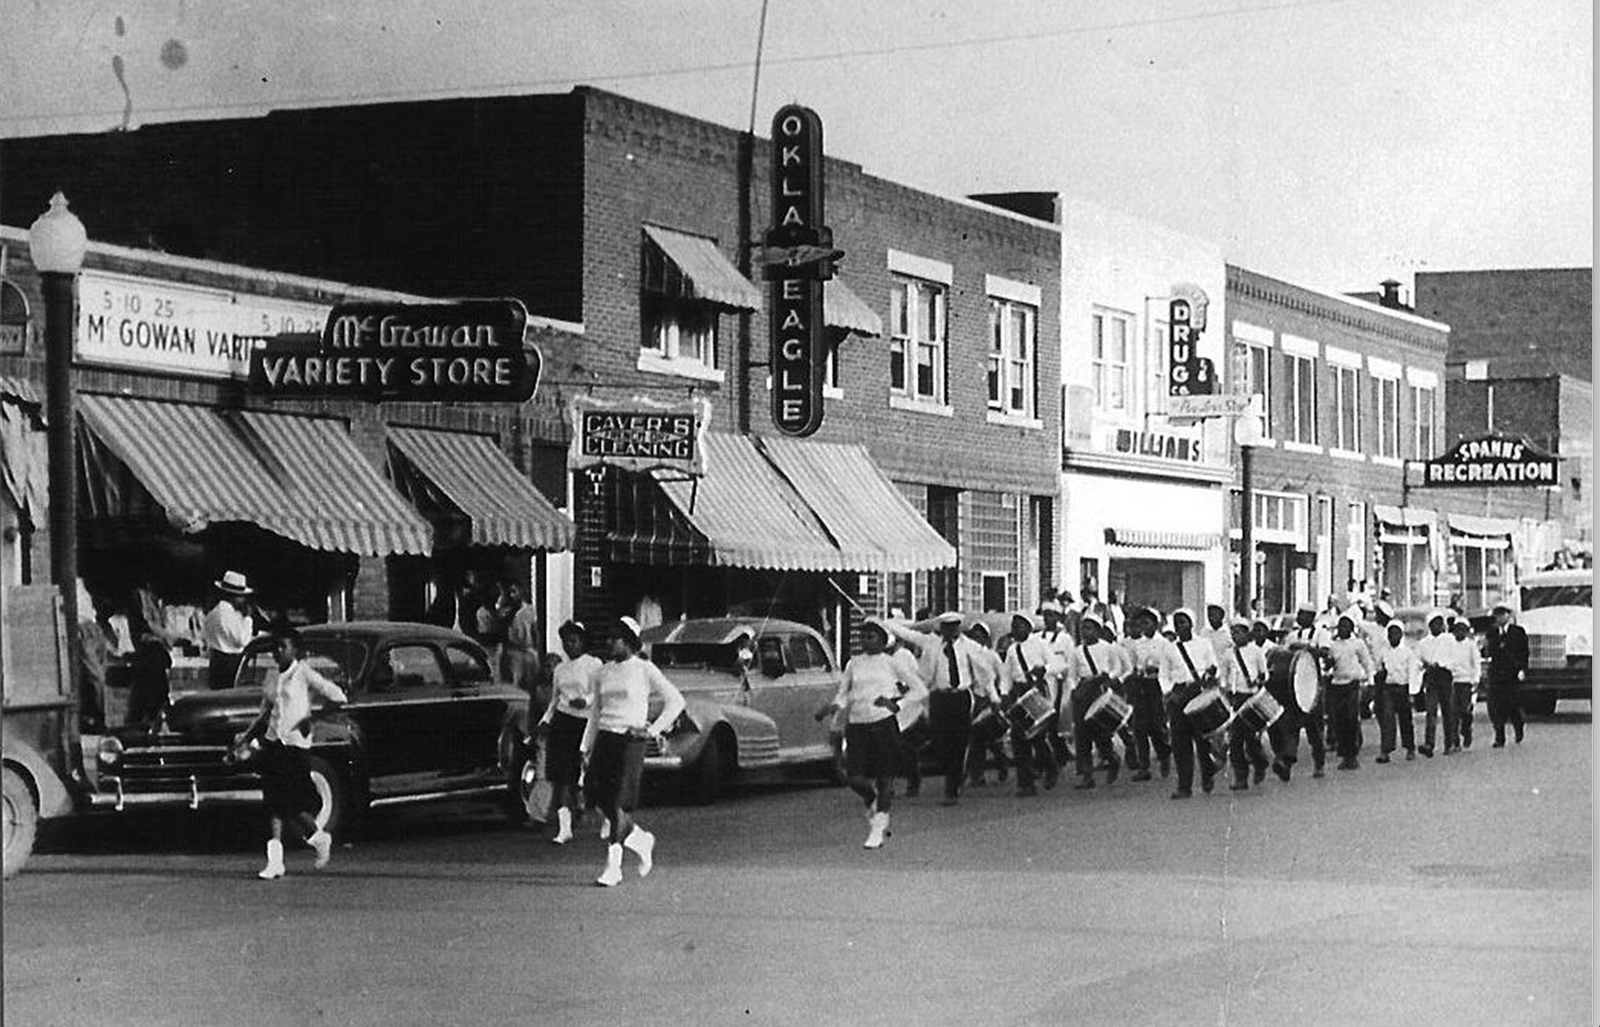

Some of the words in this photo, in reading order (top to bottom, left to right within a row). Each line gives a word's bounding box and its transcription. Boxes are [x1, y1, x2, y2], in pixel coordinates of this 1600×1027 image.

[782, 115, 803, 226] OKLA
[207, 331, 249, 362] VARI
[782, 279, 803, 420] EAGLE
[1172, 305, 1190, 383] DRUG
[262, 357, 394, 387] VARIETY
[410, 357, 511, 385] STORE
[1429, 462, 1553, 482] RECREATION
